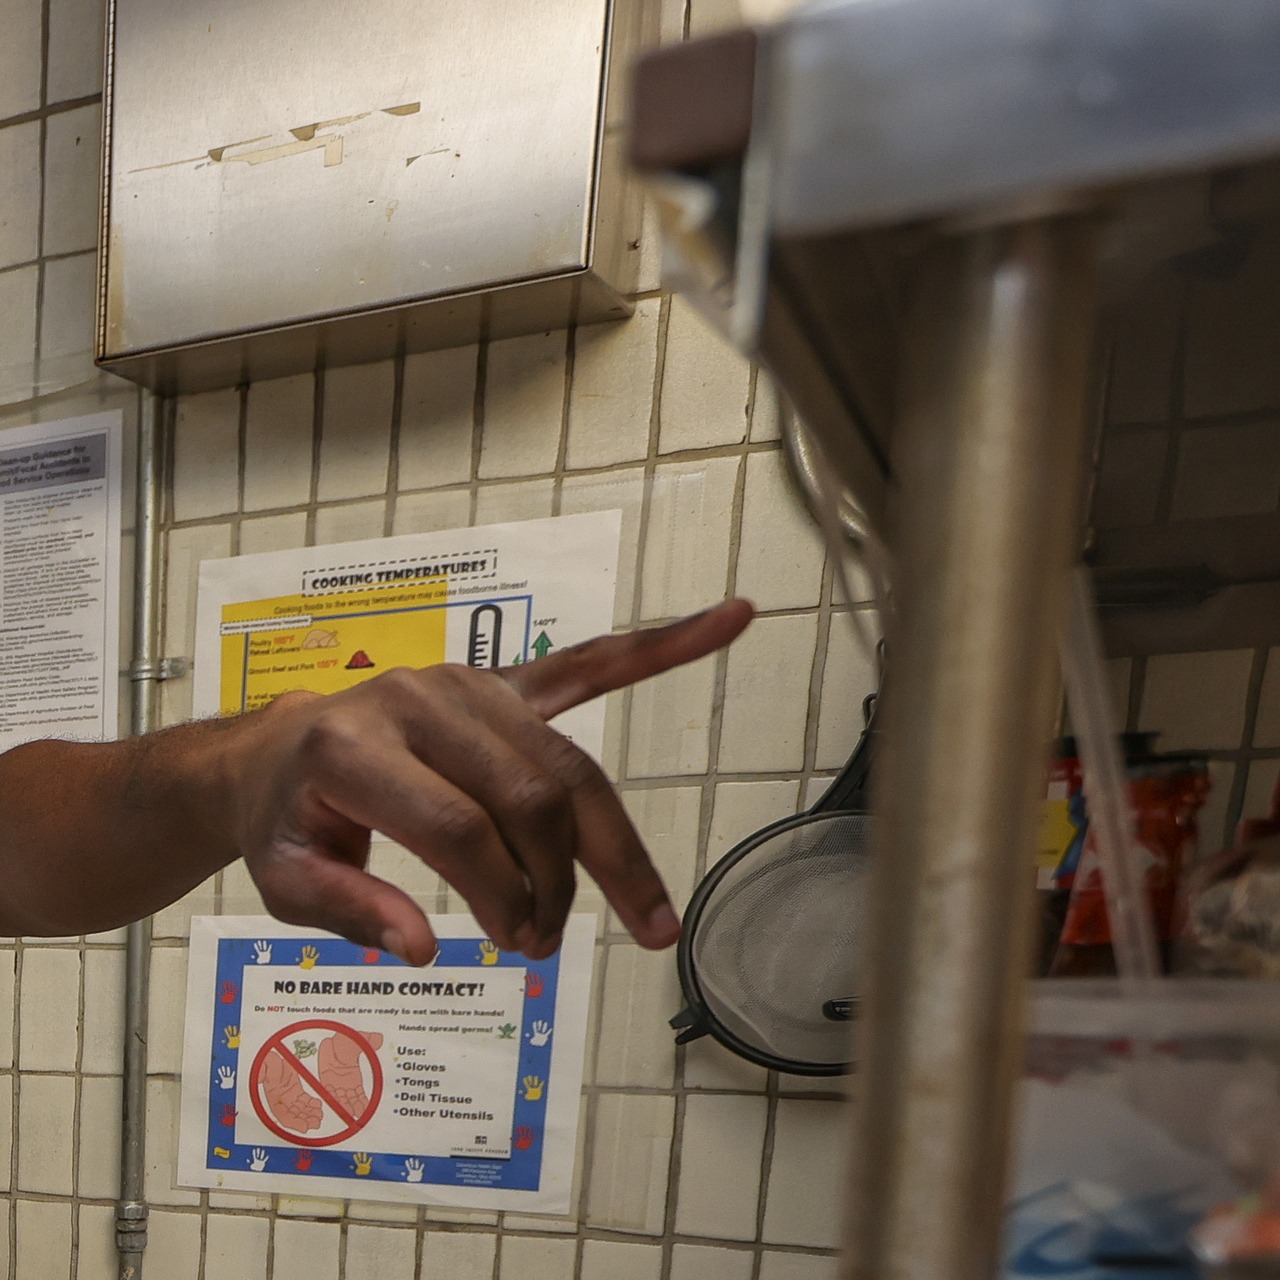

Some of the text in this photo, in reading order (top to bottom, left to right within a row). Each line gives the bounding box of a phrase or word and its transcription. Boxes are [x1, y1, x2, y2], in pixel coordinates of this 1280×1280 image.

[312, 559, 487, 590] COOKING TEMPERATURES
[274, 605, 302, 615] Cooking
[304, 602, 323, 611] foods
[348, 599, 369, 608] wrong
[417, 591, 433, 600] may
[434, 589, 457, 598] cause
[458, 584, 496, 595] foodborne
[499, 580, 528, 590] illness!
[274, 981, 485, 996] NO BARE HAND CONTACT!
[374, 1008, 399, 1016] ready
[430, 1008, 449, 1016] with
[451, 1008, 471, 1016] bare
[474, 1009, 505, 1017] hands!
[428, 1025, 459, 1033] spread
[462, 1026, 493, 1034] germs!
[397, 1046, 426, 1056] Use:
[402, 1062, 446, 1072] Gloves
[402, 1077, 440, 1089] Tongs
[400, 1092, 473, 1104] Deli Tissue
[399, 1107, 494, 1121] Other Utensils
